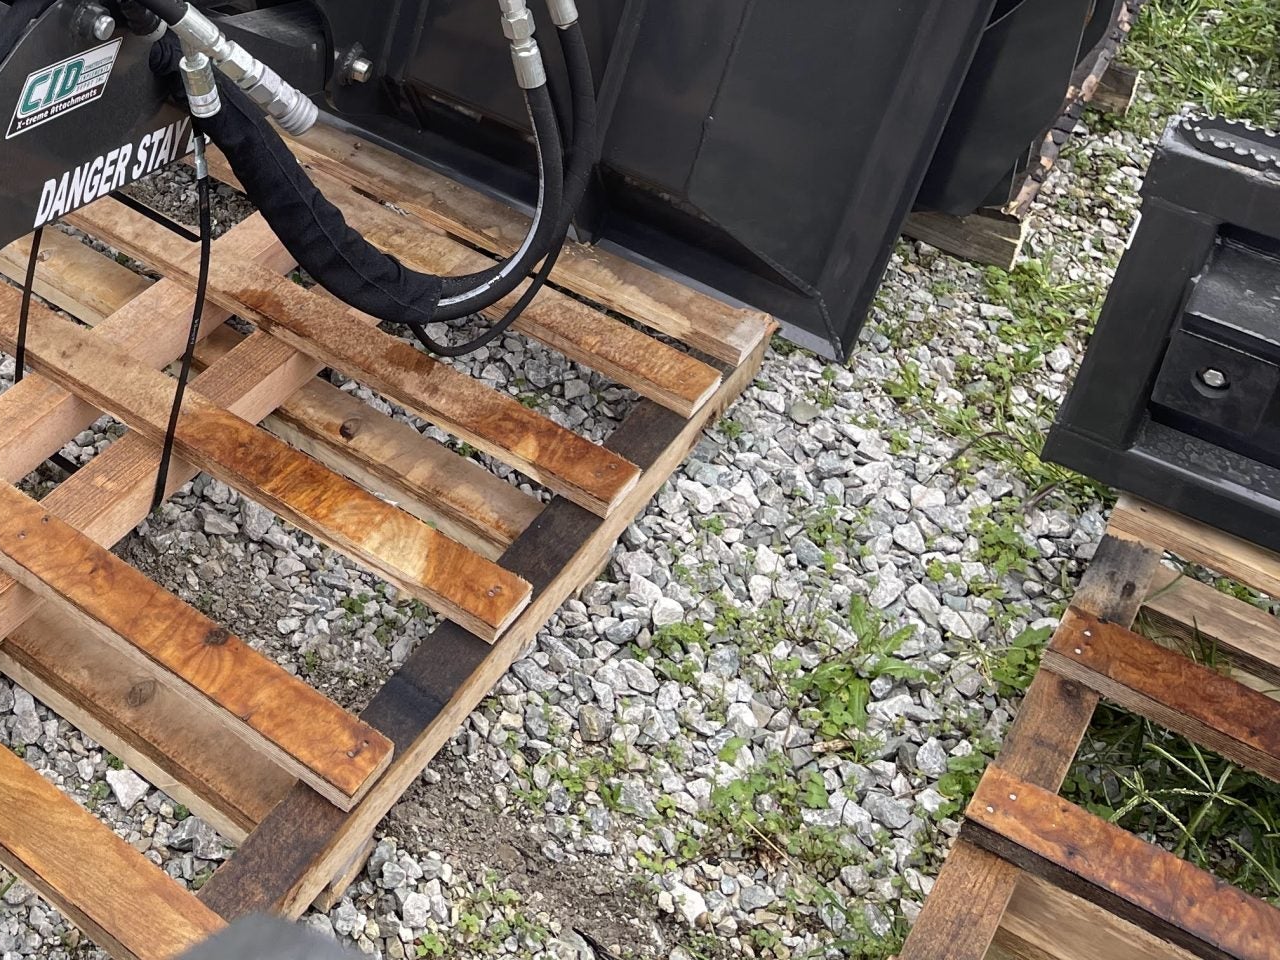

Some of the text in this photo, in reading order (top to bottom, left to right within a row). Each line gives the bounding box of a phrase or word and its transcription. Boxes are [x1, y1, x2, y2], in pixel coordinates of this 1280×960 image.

[17, 88, 97, 130] X-treme Attachments
[20, 58, 85, 115] CID
[34, 116, 190, 228] DANGER STAY
